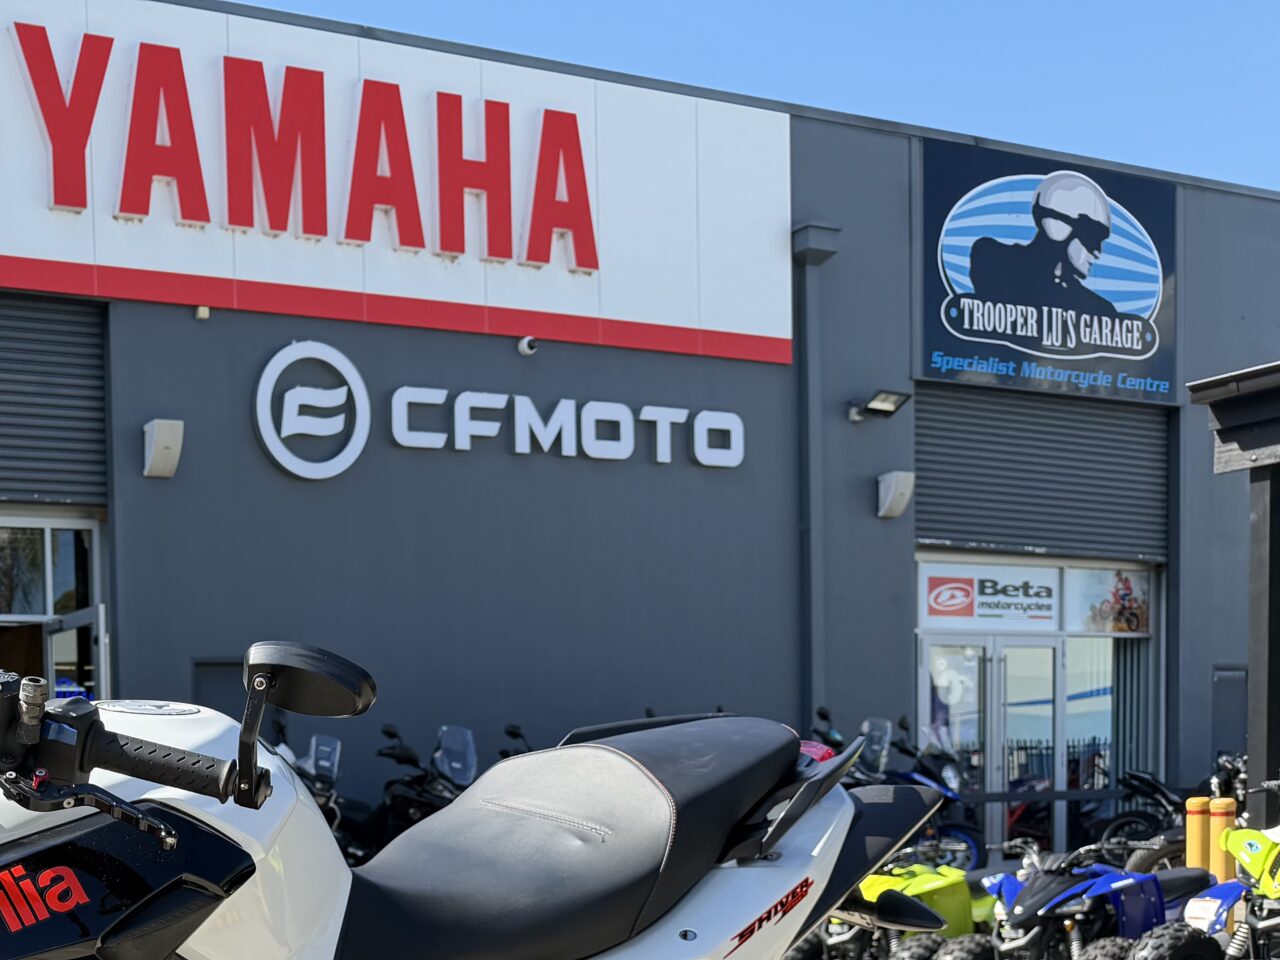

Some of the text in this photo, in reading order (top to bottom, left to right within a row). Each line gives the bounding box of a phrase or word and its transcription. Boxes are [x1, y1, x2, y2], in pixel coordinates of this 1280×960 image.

[11, 21, 600, 273] YAMAHA
[960, 298, 1143, 350] TROOPER LU'S GARAGE
[930, 351, 1169, 393] Specialist Motorcycle Centre
[391, 385, 745, 468] CFMOTO
[977, 579, 1053, 598] Beta
[977, 601, 1052, 614] motorcycles
